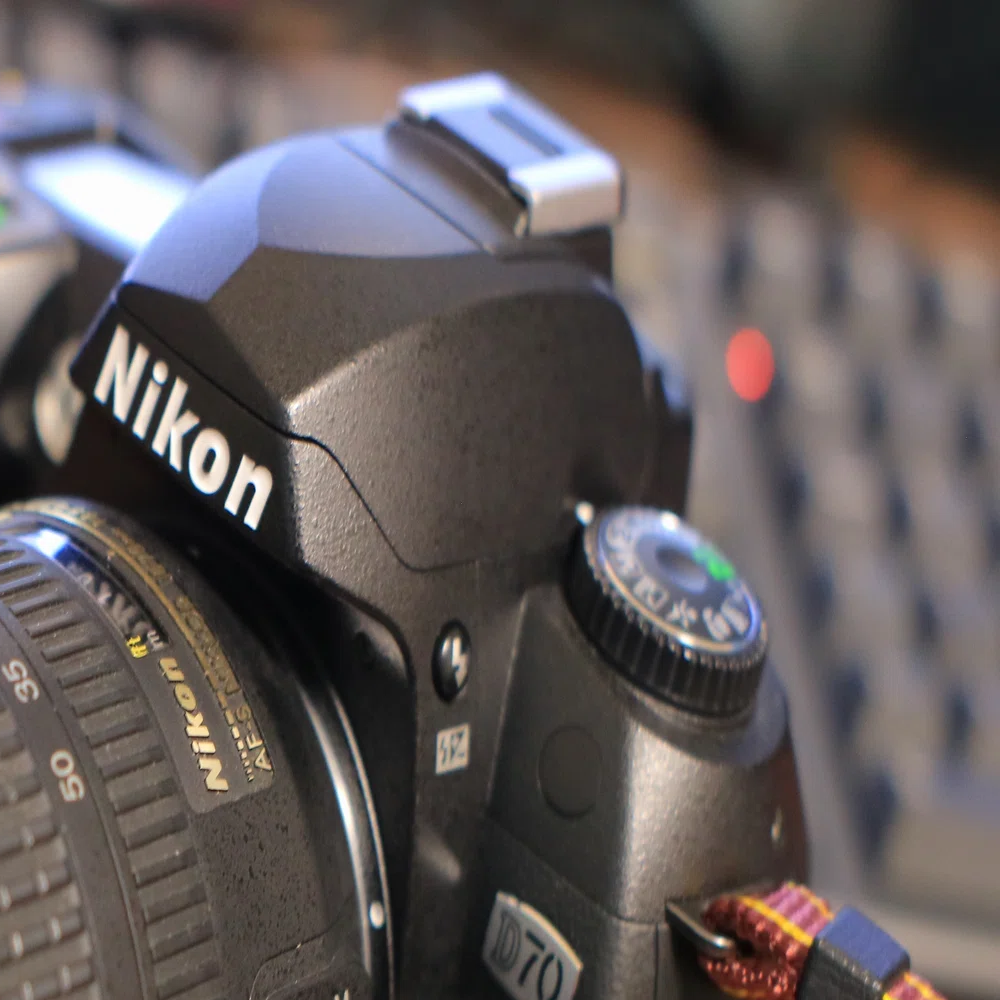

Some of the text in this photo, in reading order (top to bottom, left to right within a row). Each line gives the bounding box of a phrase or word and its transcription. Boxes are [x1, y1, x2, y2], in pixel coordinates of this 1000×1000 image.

[94, 323, 273, 531] Nikon
[1, 660, 40, 703] 35
[159, 656, 229, 791] Nikon
[235, 704, 273, 772] AF-S
[50, 749, 85, 802] 50
